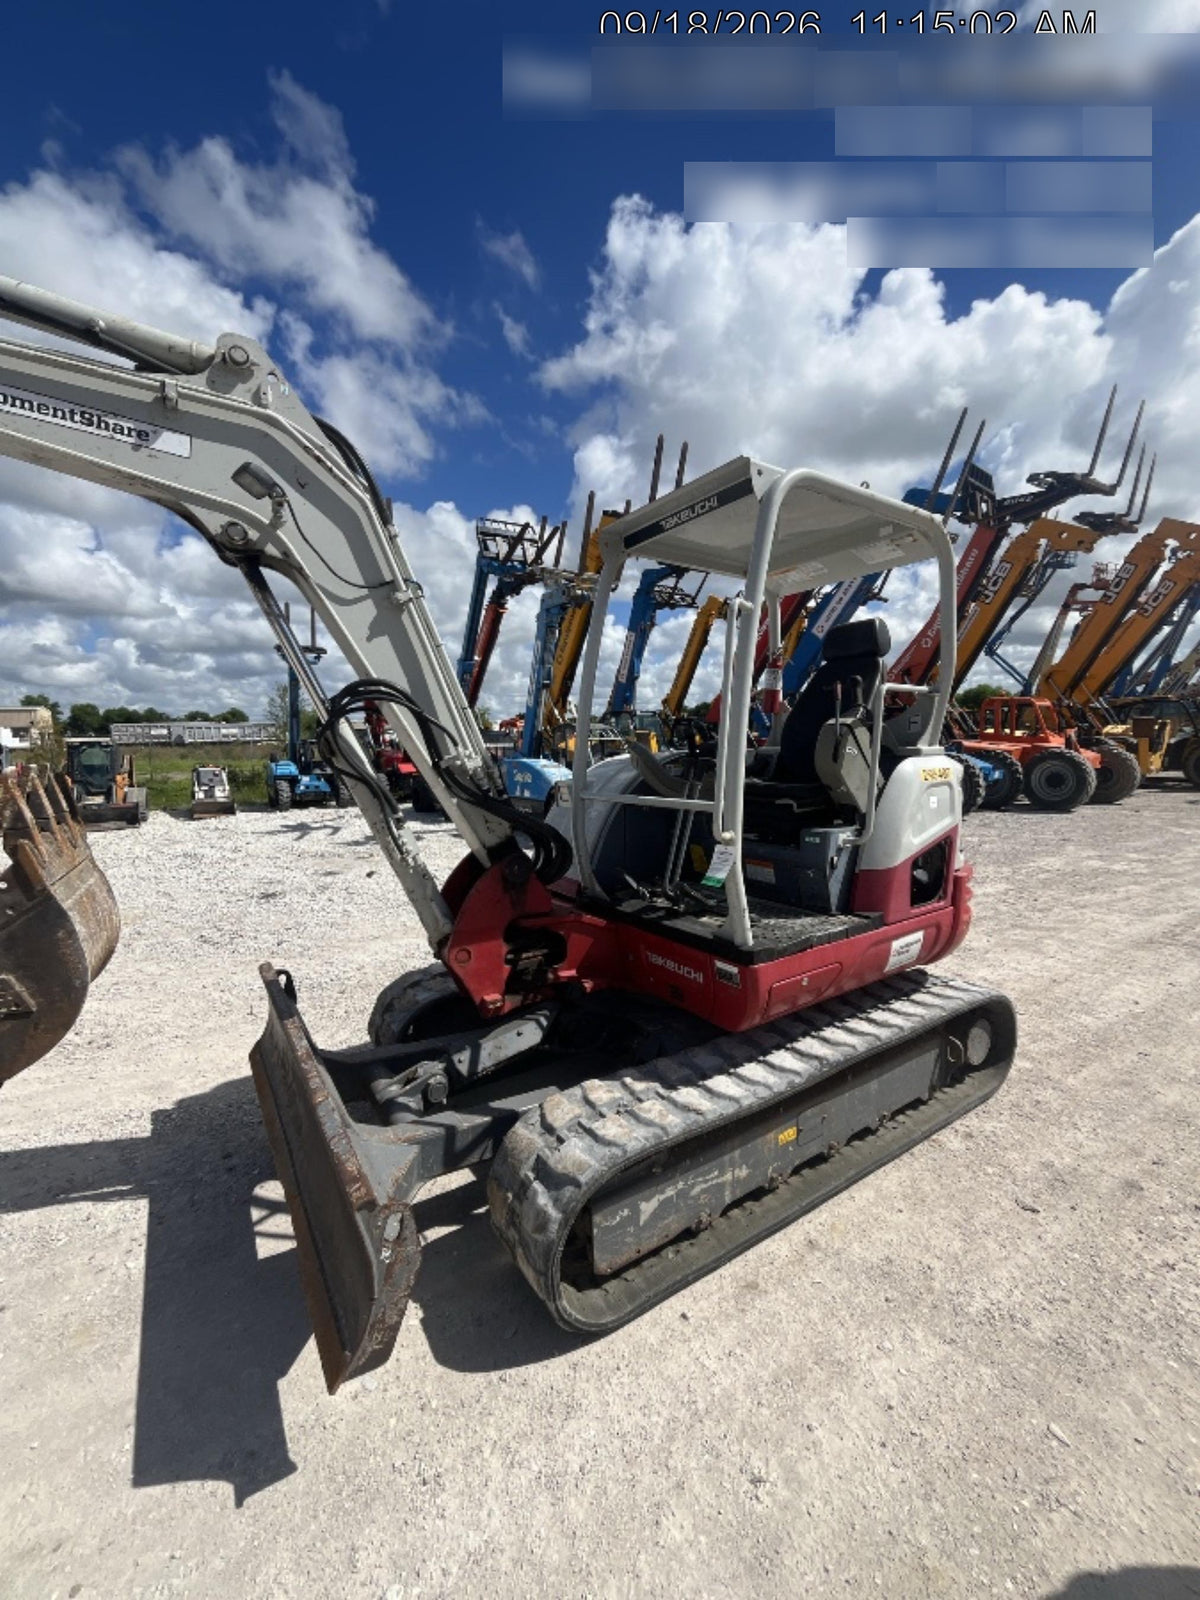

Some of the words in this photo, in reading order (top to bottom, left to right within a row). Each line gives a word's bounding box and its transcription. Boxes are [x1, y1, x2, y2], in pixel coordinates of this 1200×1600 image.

[659, 495, 718, 530] TAKEUCHI
[982, 560, 1013, 604] JCB
[1102, 562, 1137, 604] JCB
[1140, 579, 1175, 616] JCB
[646, 951, 704, 984] TAKEUCHI
